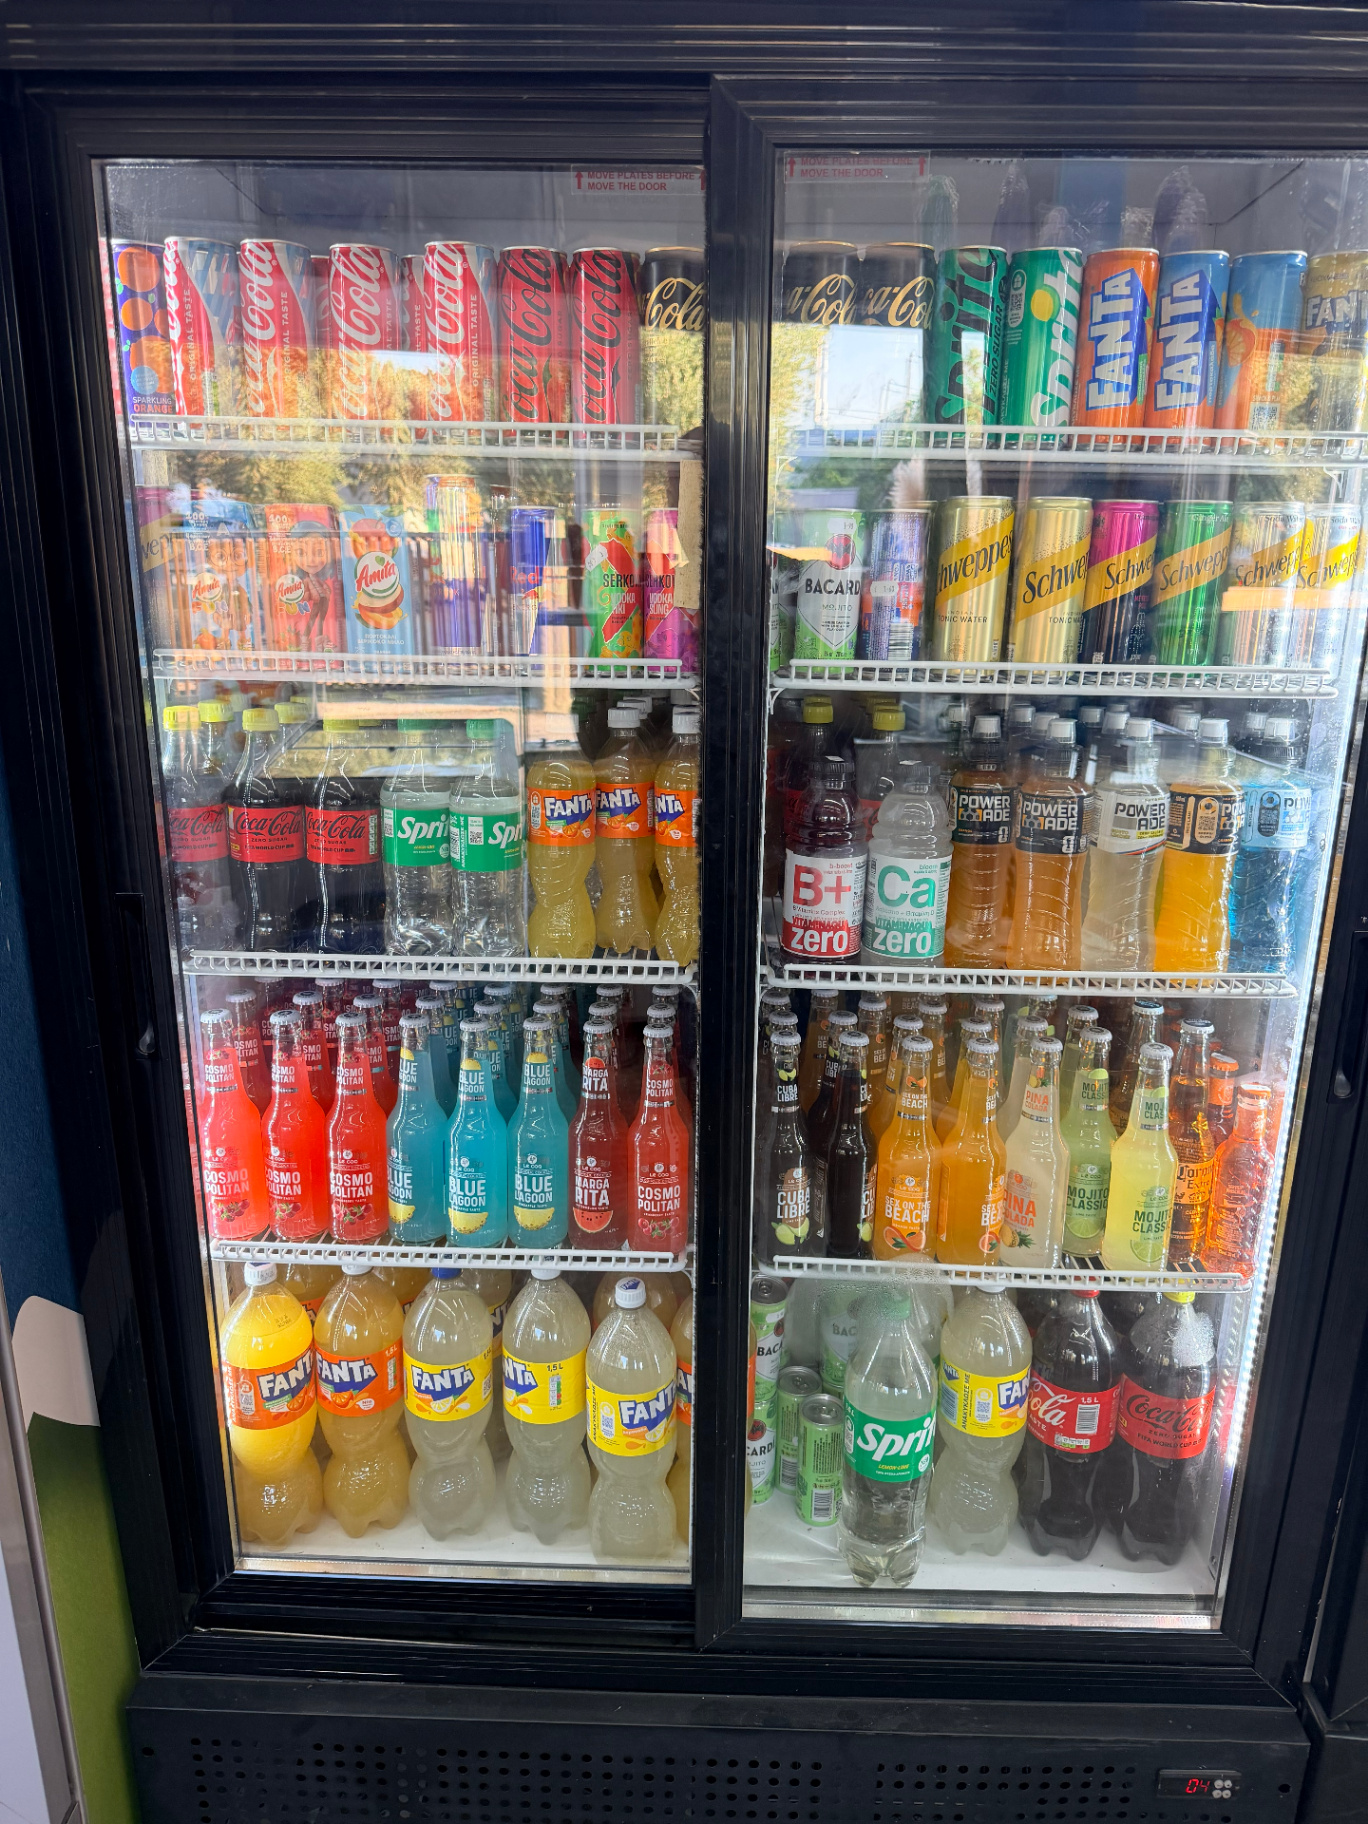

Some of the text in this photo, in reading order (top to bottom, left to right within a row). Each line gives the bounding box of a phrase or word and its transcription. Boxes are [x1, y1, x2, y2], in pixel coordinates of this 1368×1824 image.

[801, 156, 830, 165] MOVE
[588, 171, 694, 180] MOVE PLATES BEFORE
[801, 168, 884, 177] MOVE THE DOOR
[588, 182, 667, 191] MOVE THE DOOR
[281, 291, 290, 328] TASTE
[470, 294, 479, 387] ORIGINAL TASTE
[1087, 272, 1133, 408] FANTA
[1155, 273, 1203, 409] FANTA
[988, 306, 1004, 398] ZERO SUGAR
[133, 396, 172, 405] SPARKLING
[134, 404, 173, 413] ORANGE
[355, 560, 397, 592] Amita
[649, 592, 674, 604] VODKA
[649, 603, 670, 616] SLING
[959, 615, 988, 623] WATER
[543, 793, 593, 818] FANTA
[959, 794, 1010, 809] POWER
[982, 808, 1010, 822] ADE
[1023, 801, 1078, 818] POWER
[1114, 802, 1166, 818] POWER
[235, 810, 300, 837] Coca-Cola
[1044, 817, 1078, 831] ADE
[1137, 816, 1166, 831] ADE
[792, 863, 852, 907] B+
[877, 865, 937, 909] Ca
[790, 928, 849, 953] zero
[873, 929, 932, 954] zero
[204, 1063, 234, 1074] COSMO
[336, 1066, 364, 1077] COSMO
[524, 1063, 551, 1078] BLUE
[204, 1072, 235, 1083] POLITAN
[459, 1071, 485, 1085] BLUE
[523, 1075, 551, 1087] LAGOON
[582, 1076, 609, 1092] RITA
[646, 1078, 673, 1090] COSMO
[646, 1087, 674, 1098] POLITAN
[776, 1084, 798, 1095] CUBA
[776, 1092, 799, 1103] LIBRE
[901, 1097, 928, 1109] BEACH
[1025, 1090, 1049, 1106] PINA
[203, 1168, 249, 1184] COSMO
[330, 1172, 373, 1187] COSMO
[514, 1173, 553, 1193] BLUE
[575, 1176, 610, 1190] MARGA
[205, 1181, 250, 1196] POLITAN
[330, 1184, 373, 1199] POLITAN
[448, 1175, 486, 1196] BLUE
[637, 1184, 681, 1201] COSMO
[1067, 1185, 1109, 1200] MOJITO
[448, 1192, 486, 1208] LAGOON
[514, 1189, 553, 1204] LAGOON
[575, 1186, 610, 1207] RITA
[776, 1187, 811, 1207] CUBA
[885, 1195, 932, 1211] SEX ON THE
[637, 1197, 681, 1213] POLITAN
[776, 1201, 811, 1219] LIBRE
[885, 1206, 930, 1225] BEACH
[316, 1351, 377, 1383] FANTA
[546, 1364, 558, 1373] 1,5
[411, 1364, 475, 1393] FANTA
[1028, 1414, 1048, 1433] ASTE
[1185, 1778, 1211, 1794] 04
